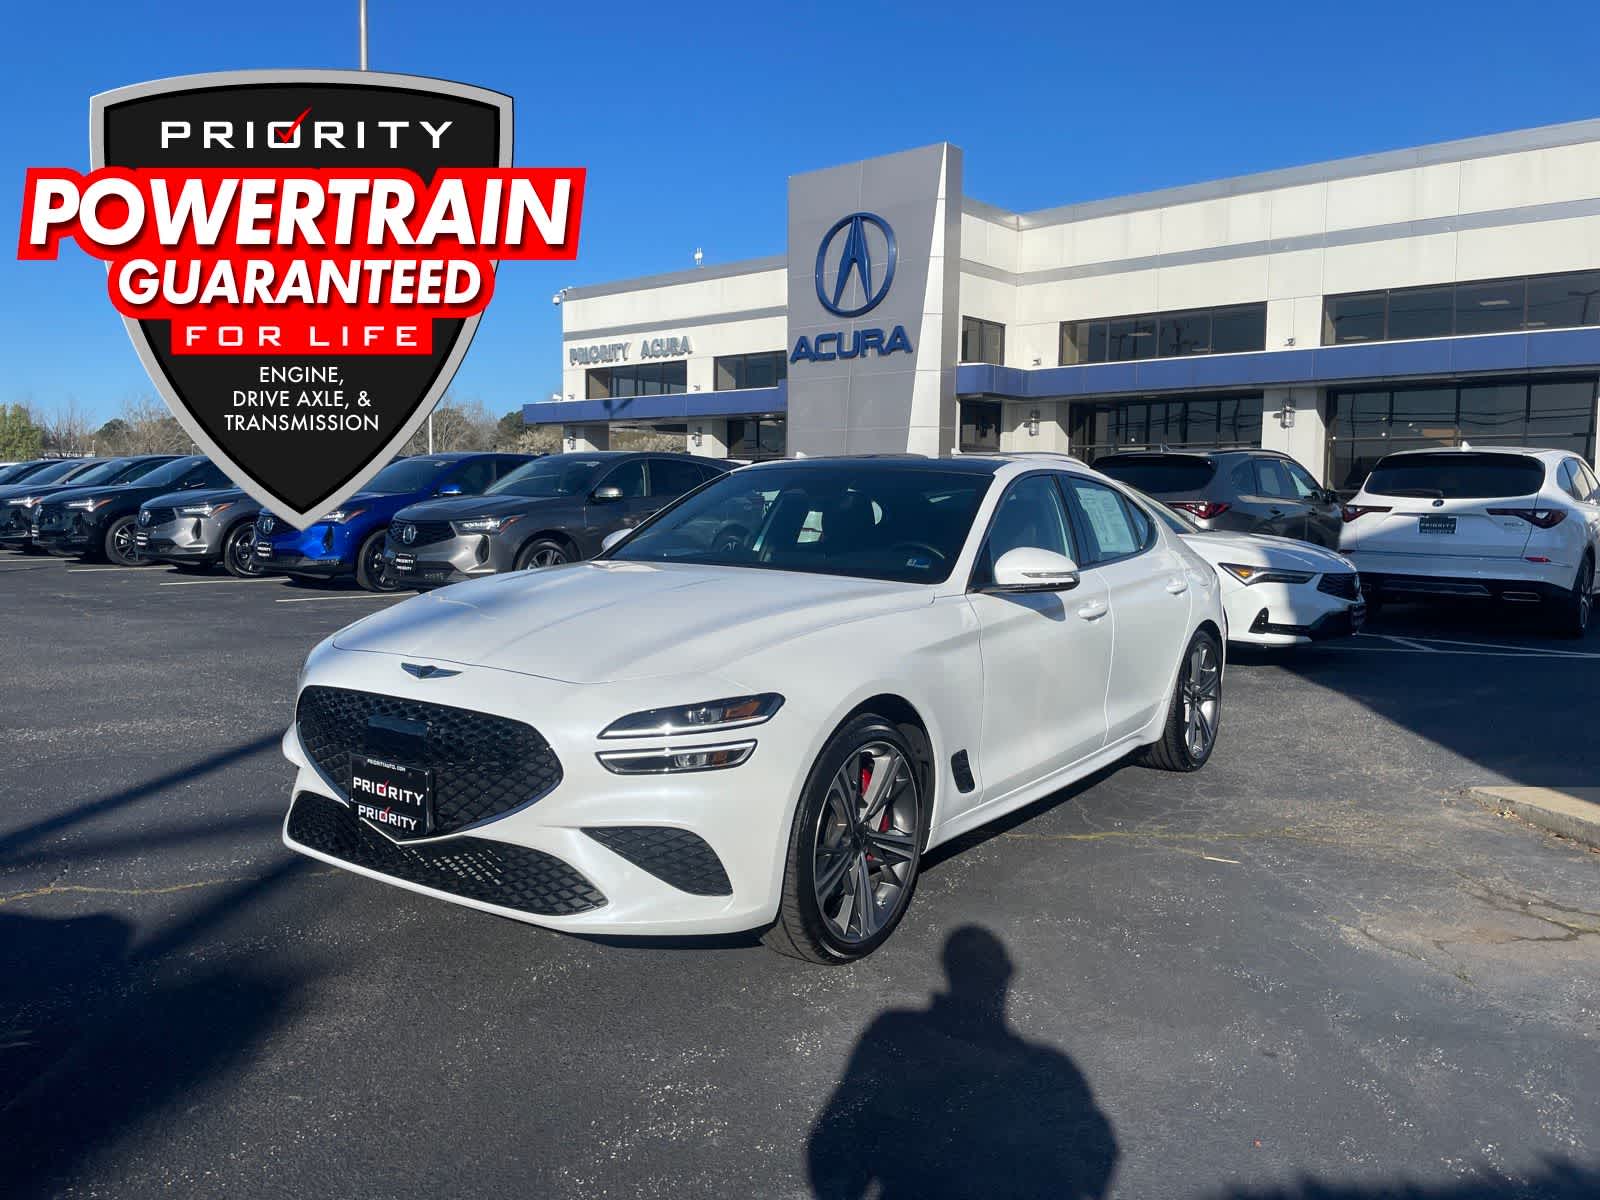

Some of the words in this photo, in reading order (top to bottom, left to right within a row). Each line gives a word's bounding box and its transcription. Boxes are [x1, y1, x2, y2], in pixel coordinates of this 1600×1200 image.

[569, 343, 632, 366] PRIORITY
[640, 336, 693, 360] ACURA
[790, 325, 913, 363] ACURA
[353, 776, 424, 806] PRIORITY
[358, 805, 417, 831] PRIORITY
